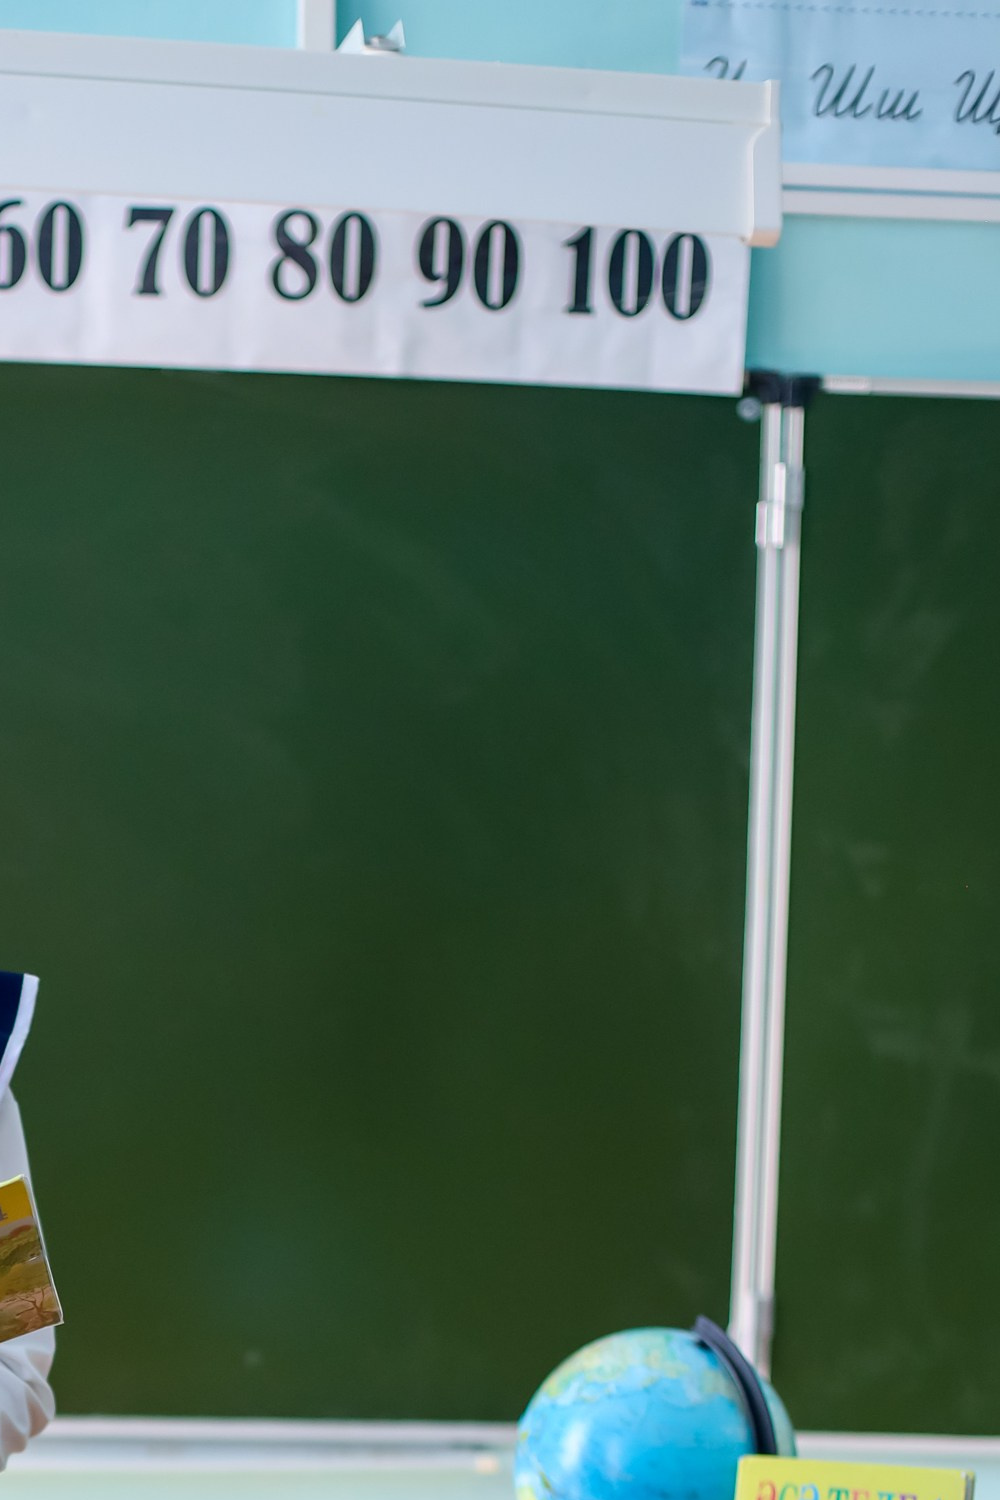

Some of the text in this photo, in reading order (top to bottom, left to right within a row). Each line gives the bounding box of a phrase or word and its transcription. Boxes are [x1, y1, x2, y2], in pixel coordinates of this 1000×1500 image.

[126, 206, 229, 297] 70
[272, 209, 375, 302] 80
[418, 214, 520, 311] 90
[564, 226, 708, 320] 100
